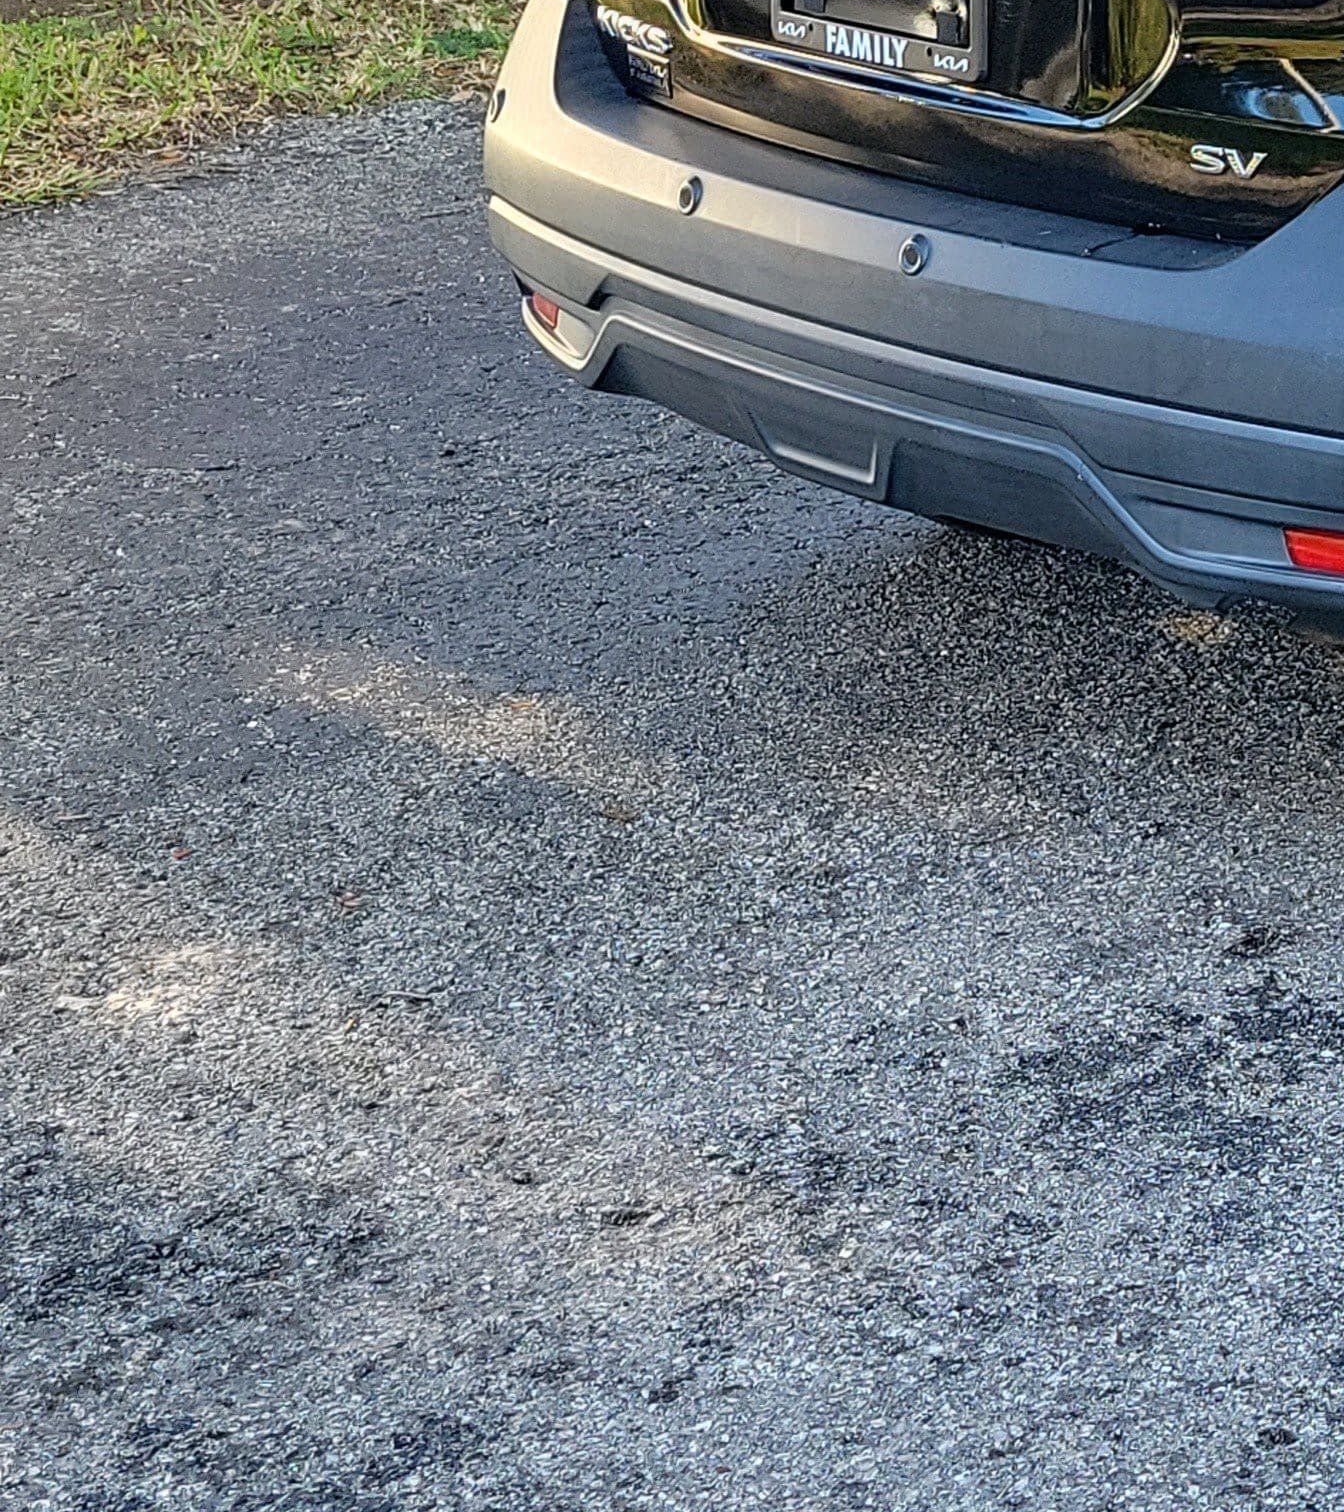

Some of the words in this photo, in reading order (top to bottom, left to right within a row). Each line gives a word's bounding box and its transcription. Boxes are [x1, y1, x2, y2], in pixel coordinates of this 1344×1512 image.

[597, 5, 672, 55] KICKS
[777, 21, 807, 38] KIA
[825, 24, 909, 68] FAMILY
[933, 53, 969, 73] KIA
[1190, 144, 1269, 179] SV
